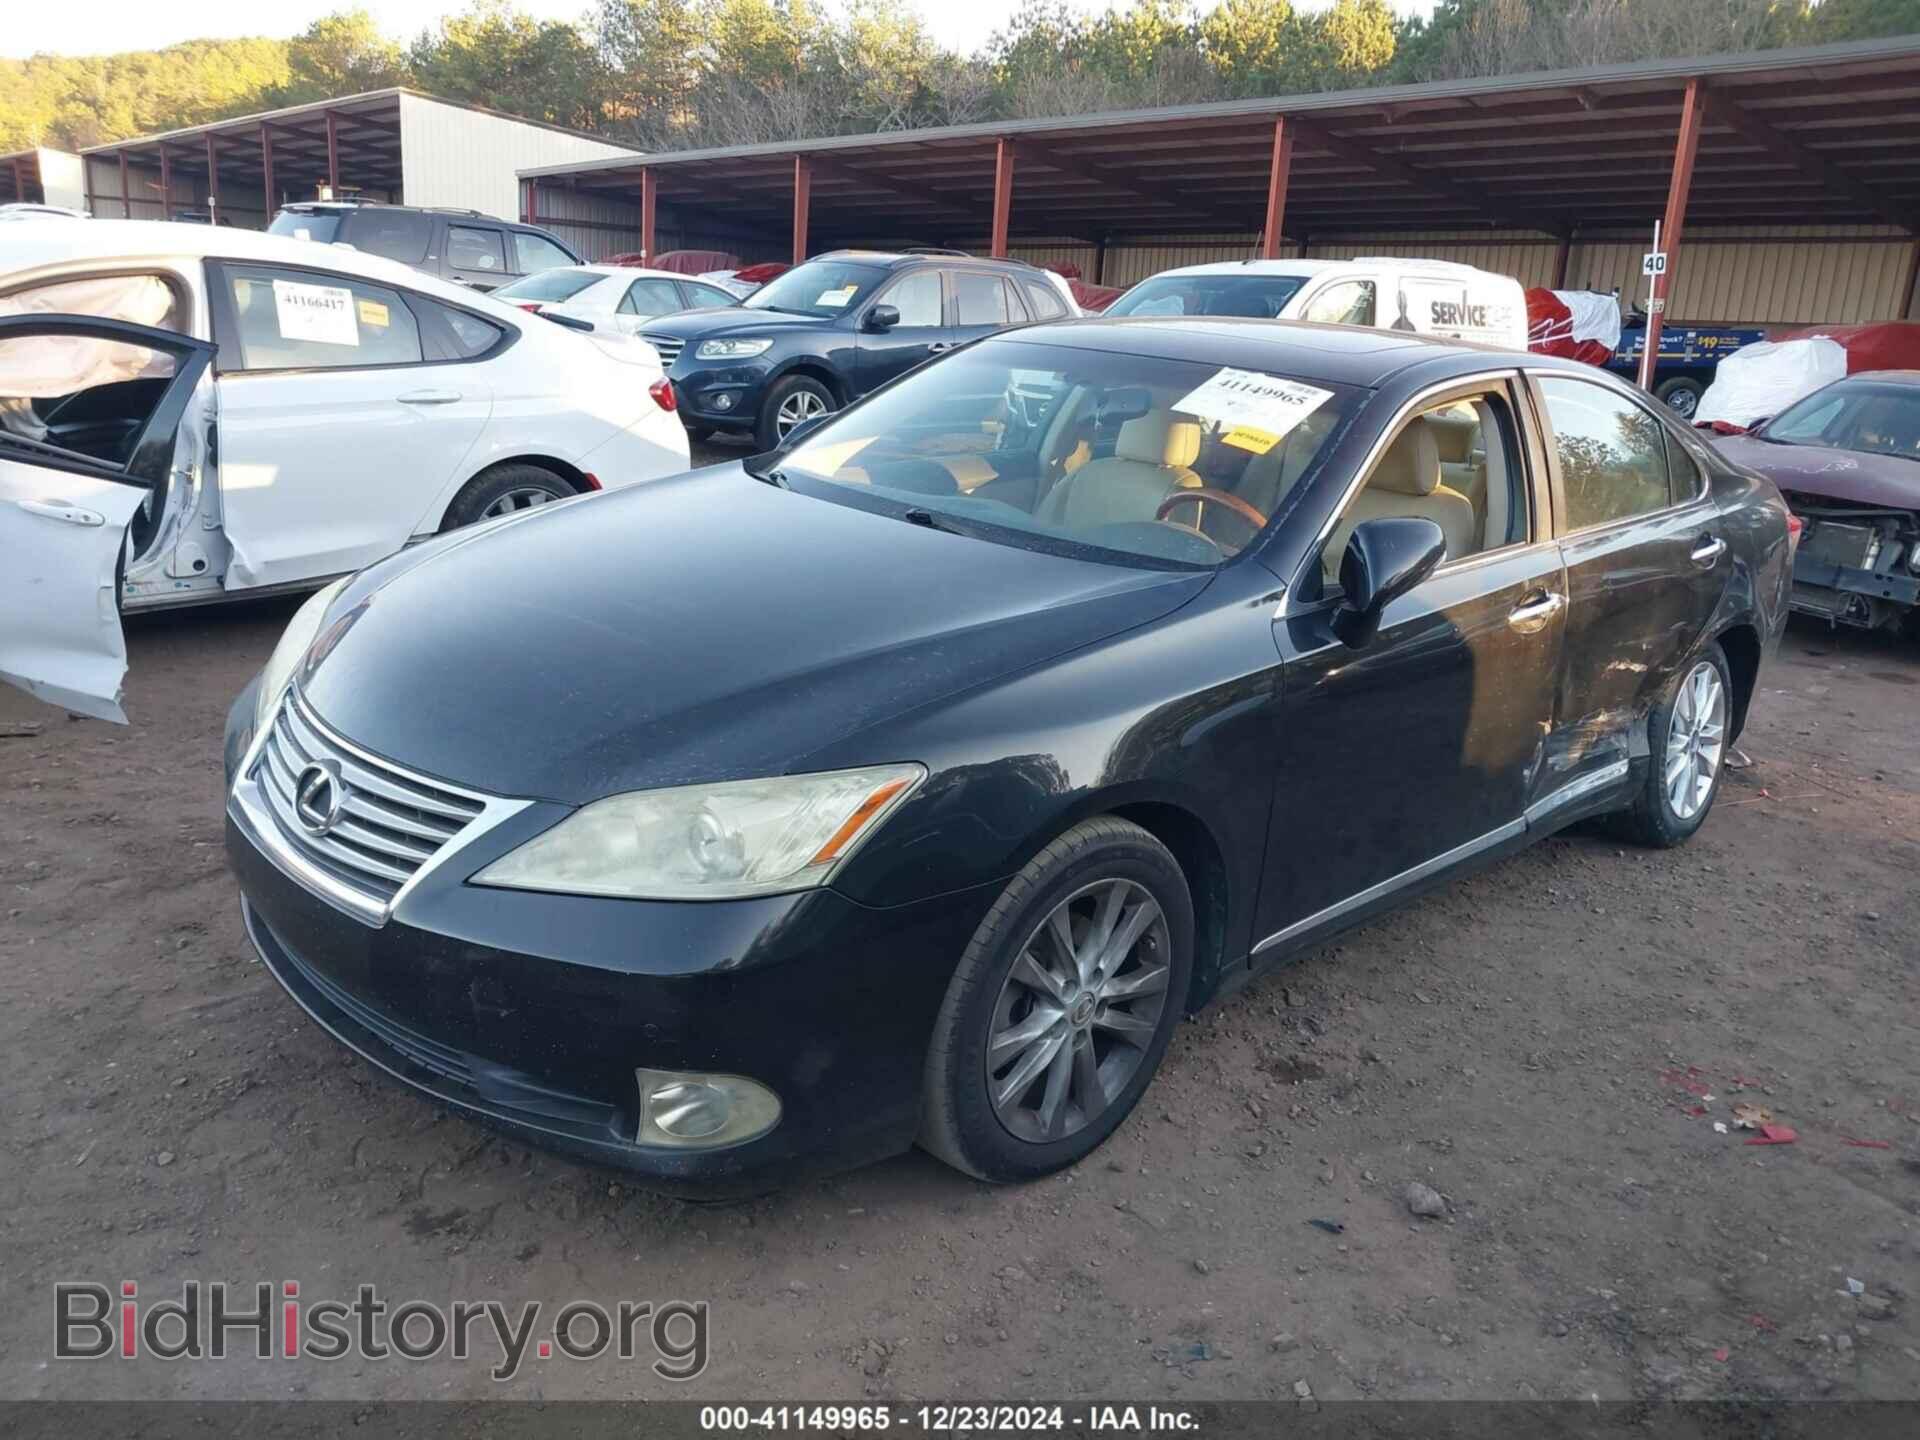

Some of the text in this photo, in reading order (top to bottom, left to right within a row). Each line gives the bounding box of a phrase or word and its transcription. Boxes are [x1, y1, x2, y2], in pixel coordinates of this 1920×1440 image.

[1645, 256, 1665, 271] 40
[284, 294, 345, 311] 41166417
[1431, 291, 1486, 327] SERVICE
[1218, 379, 1309, 406] 41149965
